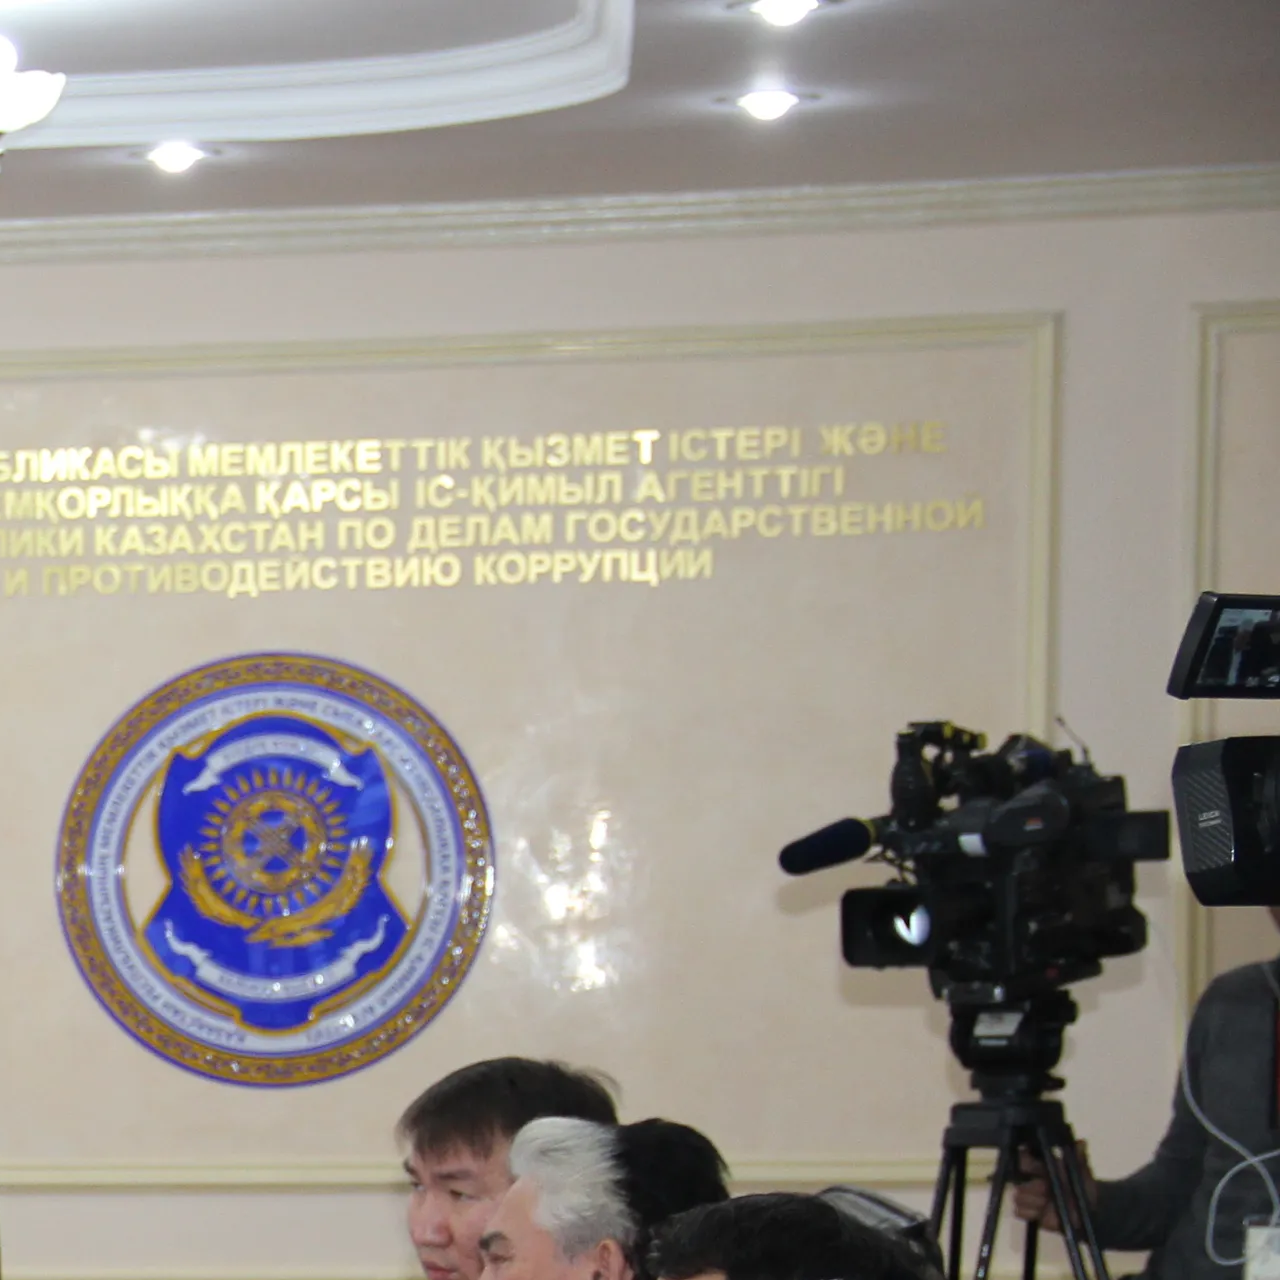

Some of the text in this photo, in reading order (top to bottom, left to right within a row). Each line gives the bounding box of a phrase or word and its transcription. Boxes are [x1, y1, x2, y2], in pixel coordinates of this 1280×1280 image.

[188, 437, 472, 477] МЕМЛЕКЕТТІК
[481, 429, 660, 473] ҚЫЗМЕТ
[668, 427, 801, 462] ІСТЕРІ
[819, 420, 948, 456] ЖӘНЕ
[256, 477, 399, 519] ҚАРСЫ
[415, 471, 623, 512] ІС-ҚИМЫЛ
[637, 465, 845, 503] АГЕНТТІГІ
[94, 519, 326, 557] КАЗАХСТАН
[337, 516, 396, 550] ПО
[406, 511, 554, 554] ДЕЛАМ
[564, 491, 986, 545] ГОСУДАРСТВЕННОЙ
[3, 567, 29, 598] И
[42, 552, 462, 599] ПРОТИВОДЕЙСТВИЮ
[474, 547, 714, 587] КОРРУПЦИИ
